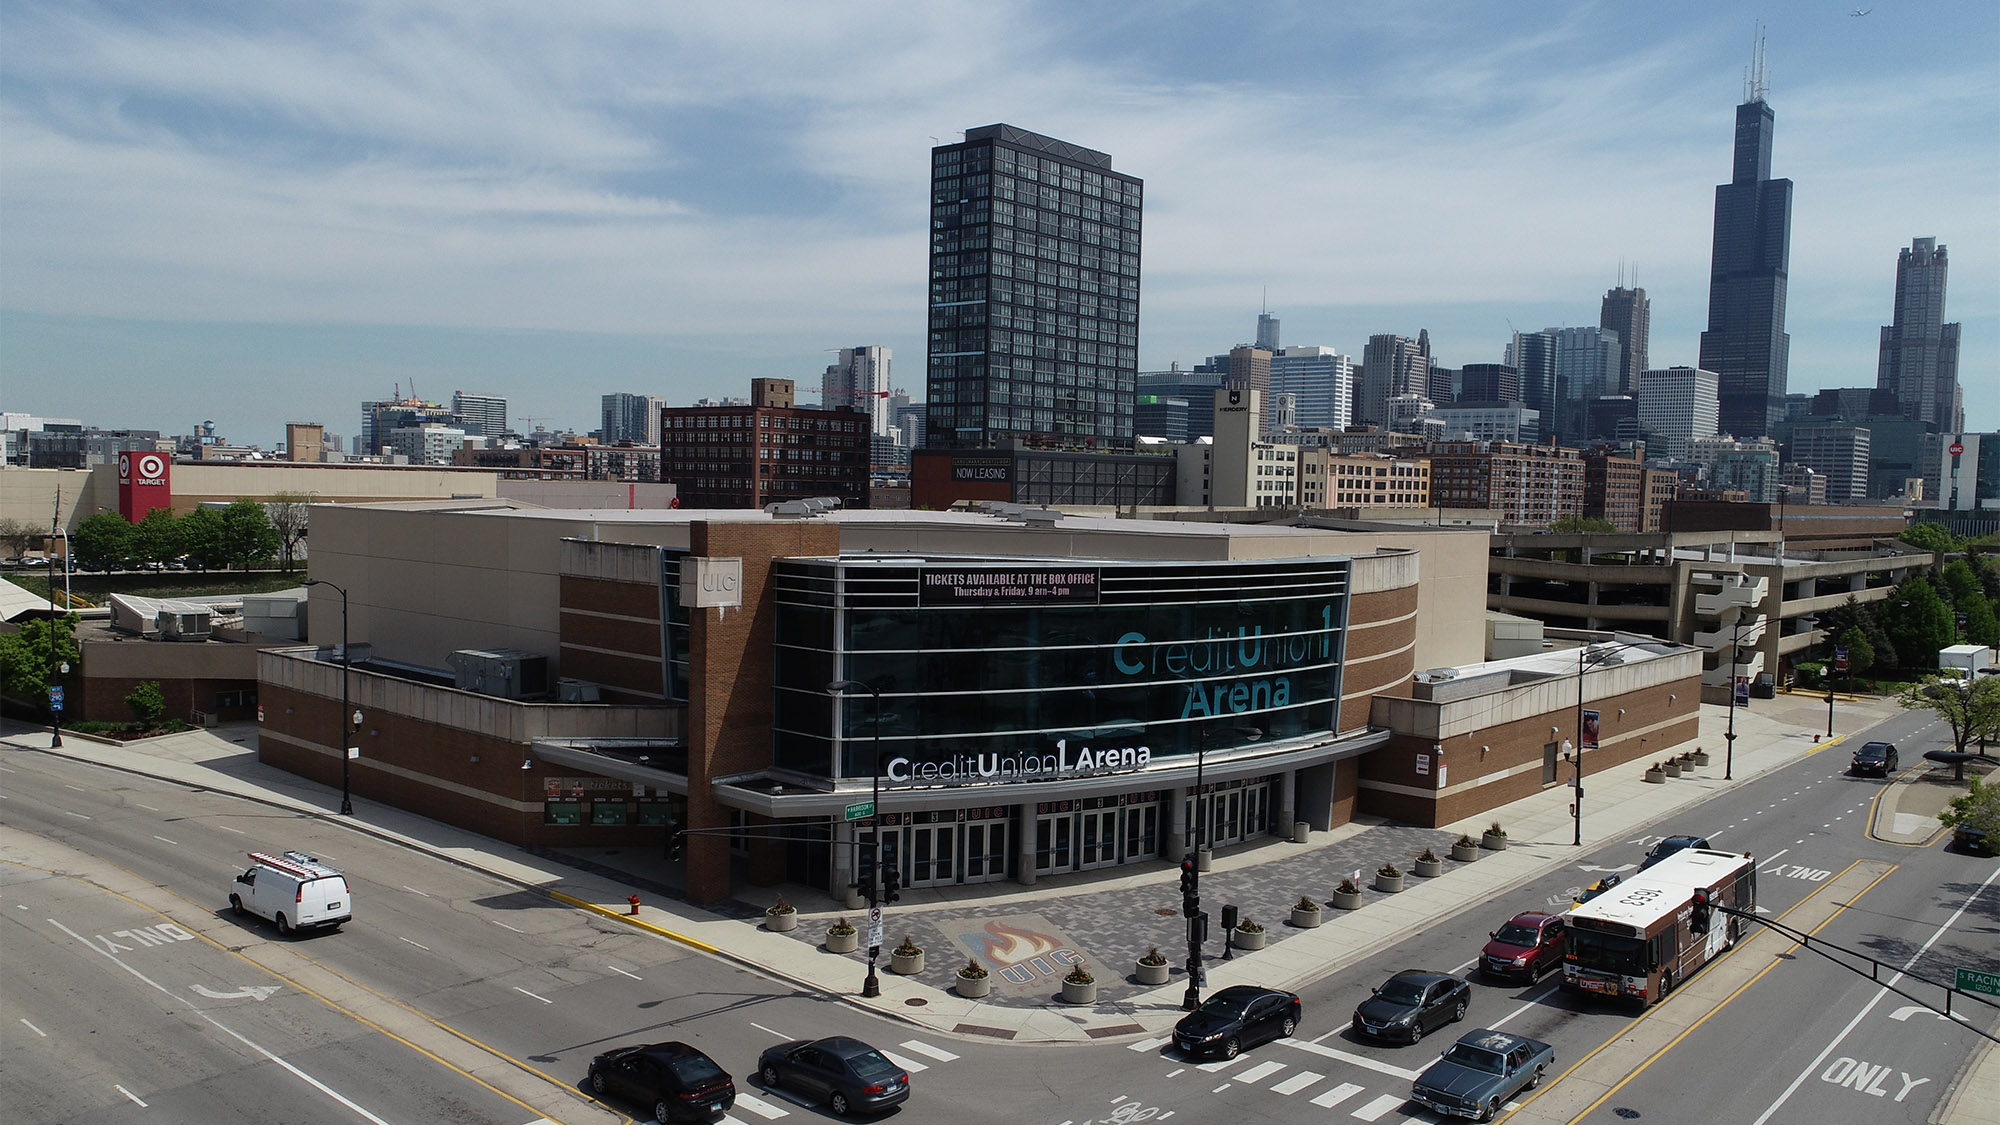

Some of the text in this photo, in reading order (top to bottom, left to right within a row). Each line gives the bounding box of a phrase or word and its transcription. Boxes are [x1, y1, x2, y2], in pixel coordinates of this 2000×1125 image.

[956, 468, 1006, 480] NOW LEASING
[703, 573, 736, 592] UIC
[925, 574, 1095, 586] TICKETS AVAILABLE AT THE BOX OFFICE
[954, 586, 992, 596] Thursday
[994, 587, 1000, 596] &
[1001, 586, 1027, 596] Friday,
[1028, 586, 1034, 596] 9
[1058, 588, 1070, 597] pm
[1114, 604, 1331, 675] CreditUnion1
[1181, 677, 1290, 720] Arena
[887, 739, 1151, 782] CreditUnion1 Arena
[590, 780, 628, 790] tickets
[972, 806, 1003, 820] UIC
[1040, 800, 1069, 813] UIC
[1626, 836, 1667, 847] LY
[1762, 864, 1832, 882] ONLY
[1619, 888, 1664, 906] 1653
[96, 924, 196, 954] ONLY
[997, 948, 1086, 984] UIC
[1976, 984, 1992, 992] 1200
[1821, 1057, 1931, 1102] ONLY
